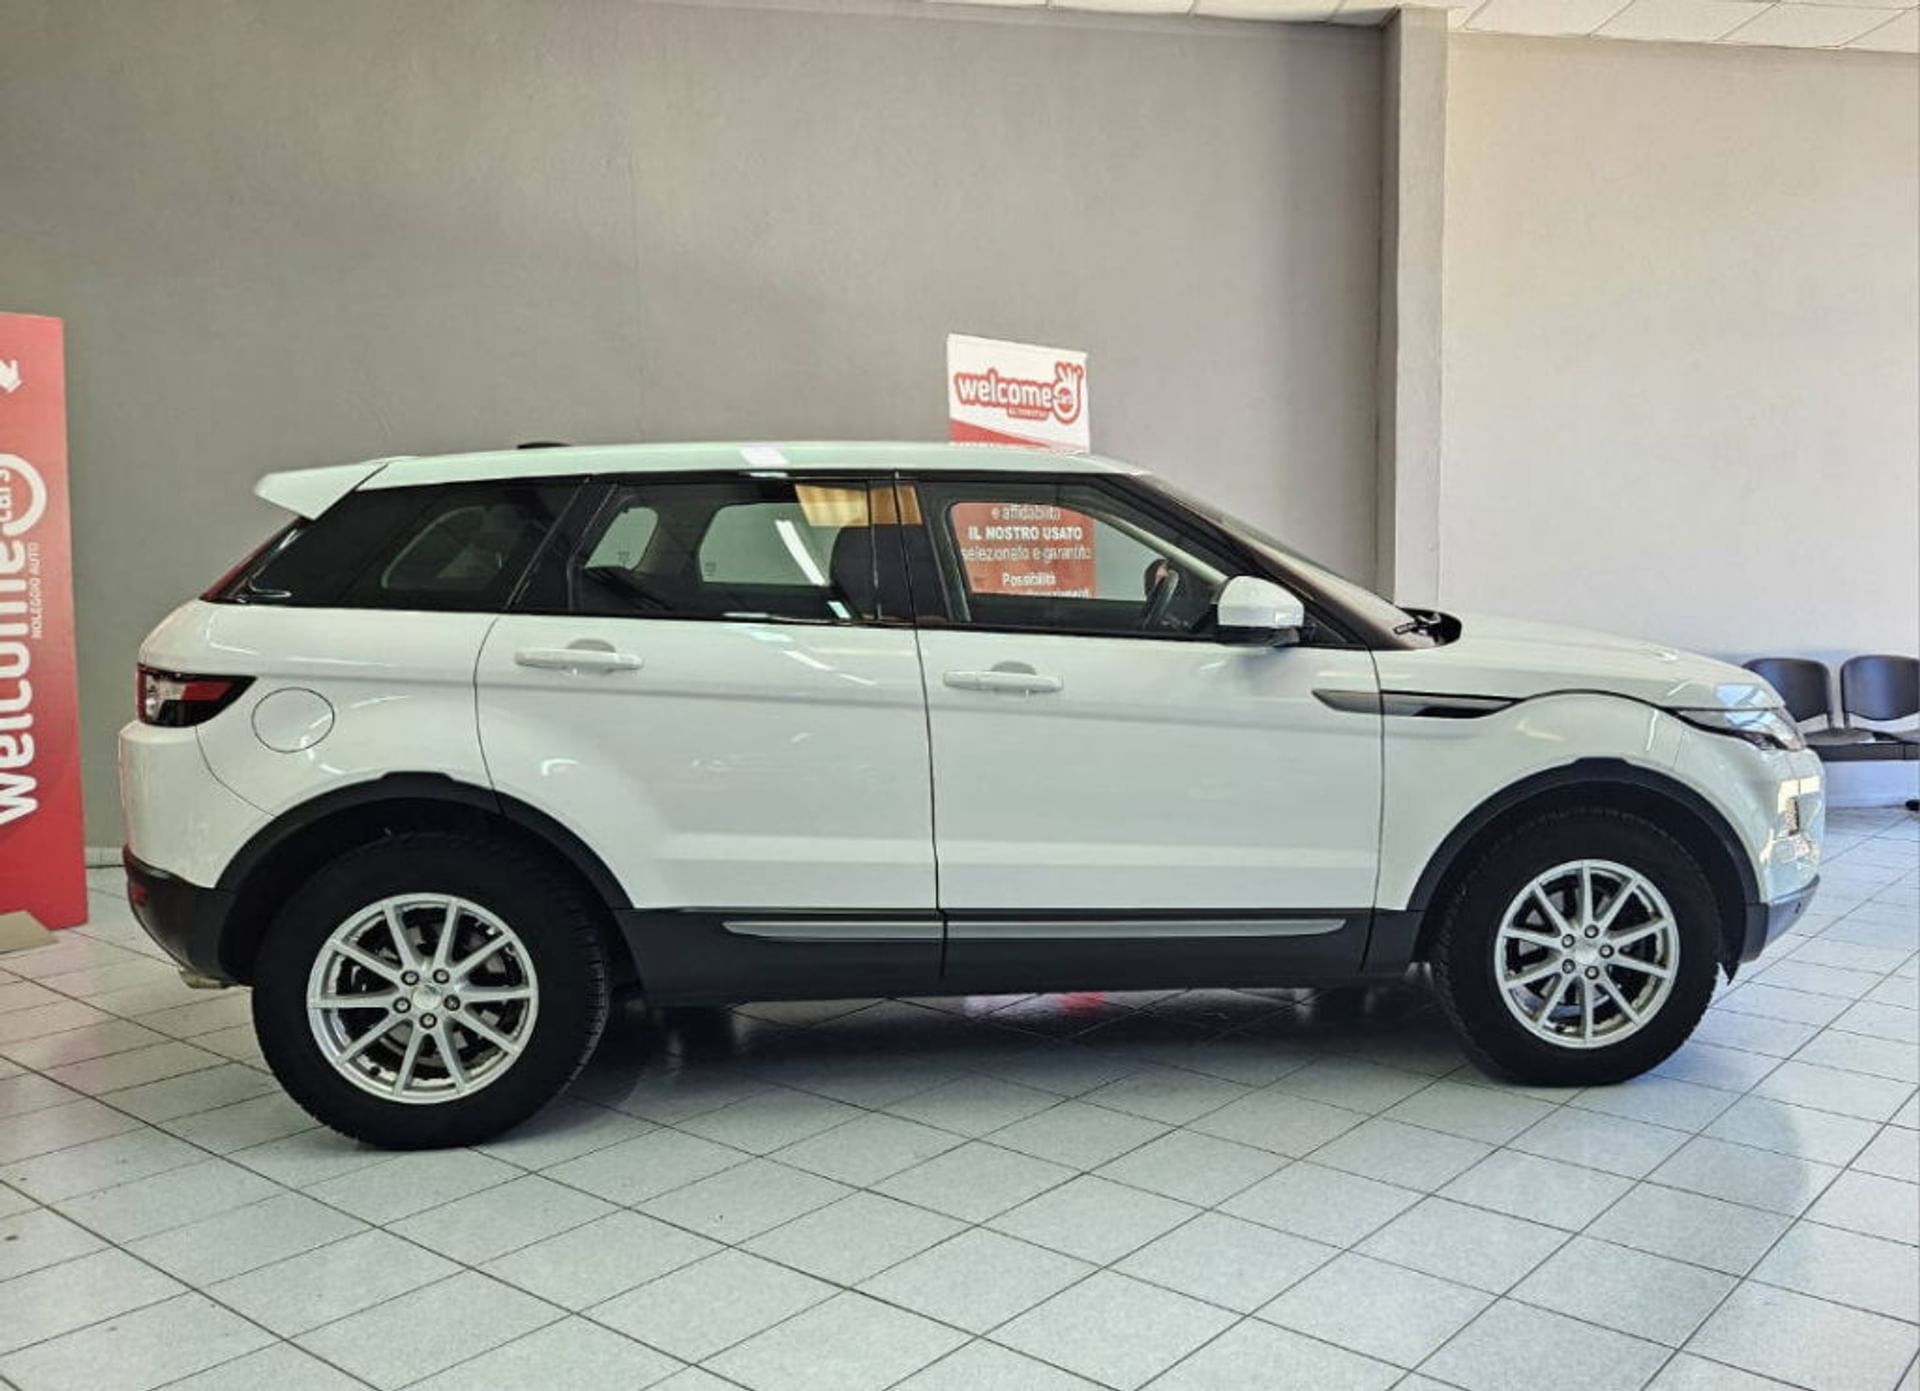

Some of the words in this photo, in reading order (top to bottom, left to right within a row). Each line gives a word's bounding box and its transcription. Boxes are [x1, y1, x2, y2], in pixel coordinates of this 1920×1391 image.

[956, 369, 1052, 408] welcome
[968, 526, 982, 540] IL
[986, 526, 1039, 540] NOSTRO
[1042, 526, 1083, 540] USATO
[28, 541, 41, 576] AUTO
[961, 545, 1030, 560] selezionato
[1033, 548, 1041, 560] e
[1043, 544, 1091, 563] garantito
[29, 577, 43, 640] NOLEGGIO
